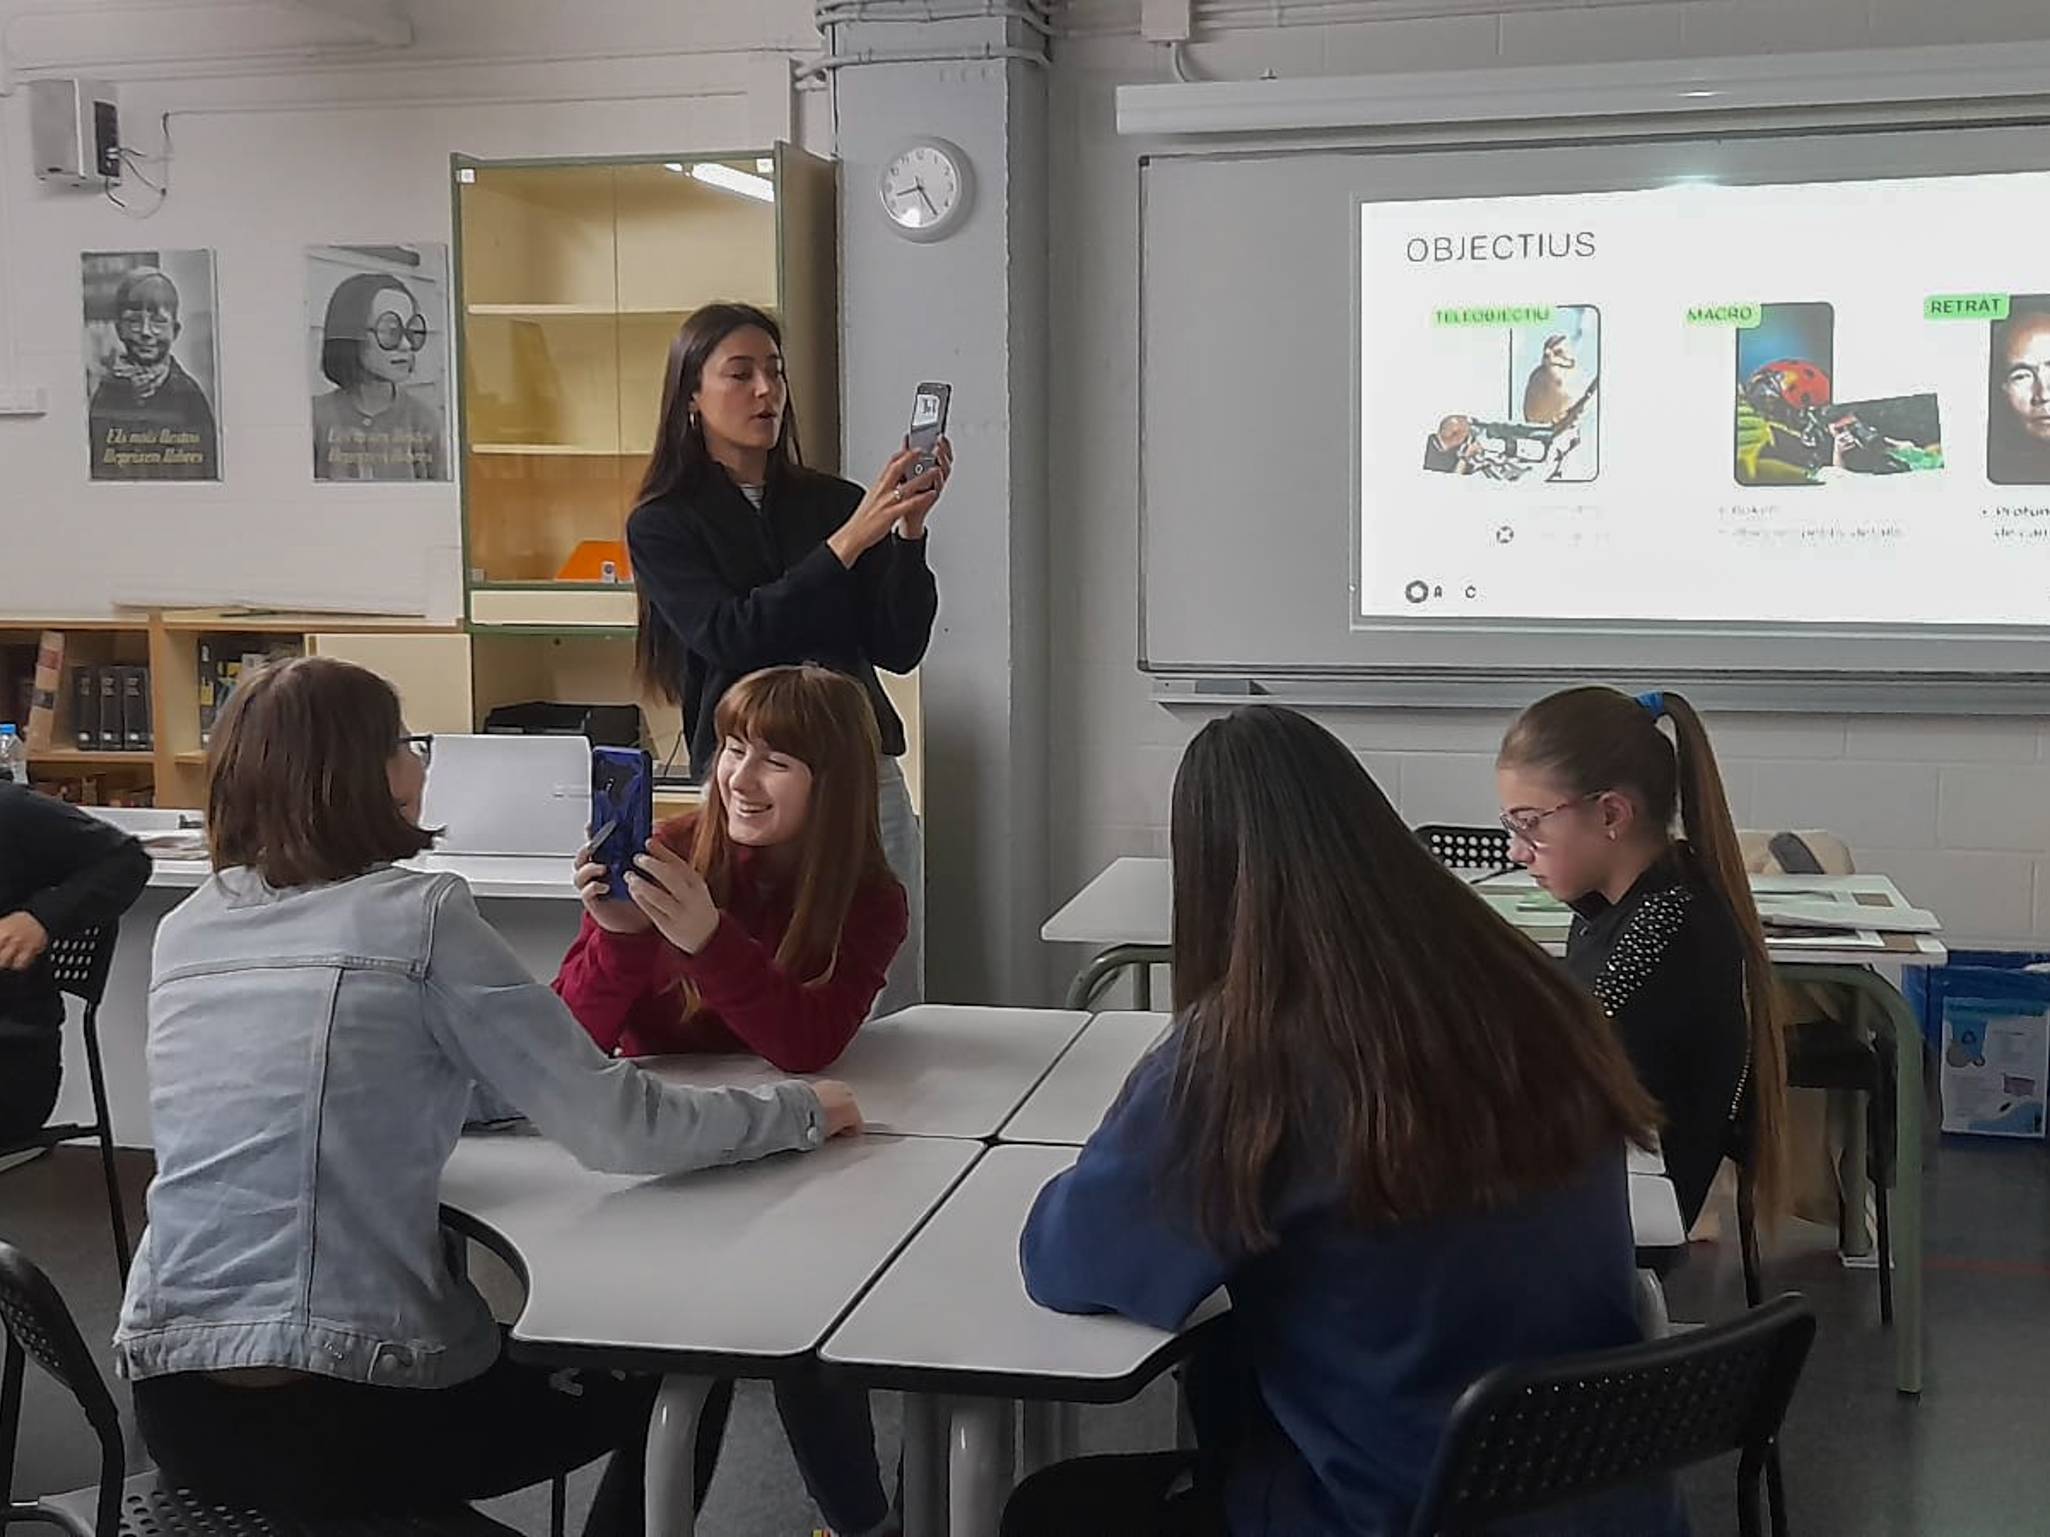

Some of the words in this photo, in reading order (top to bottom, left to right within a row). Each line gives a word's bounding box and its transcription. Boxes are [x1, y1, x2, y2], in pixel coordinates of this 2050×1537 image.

[1407, 232, 1596, 262] OBJECTIUS
[1687, 306, 1752, 321] MACRO
[1930, 298, 2001, 314] RETRAT
